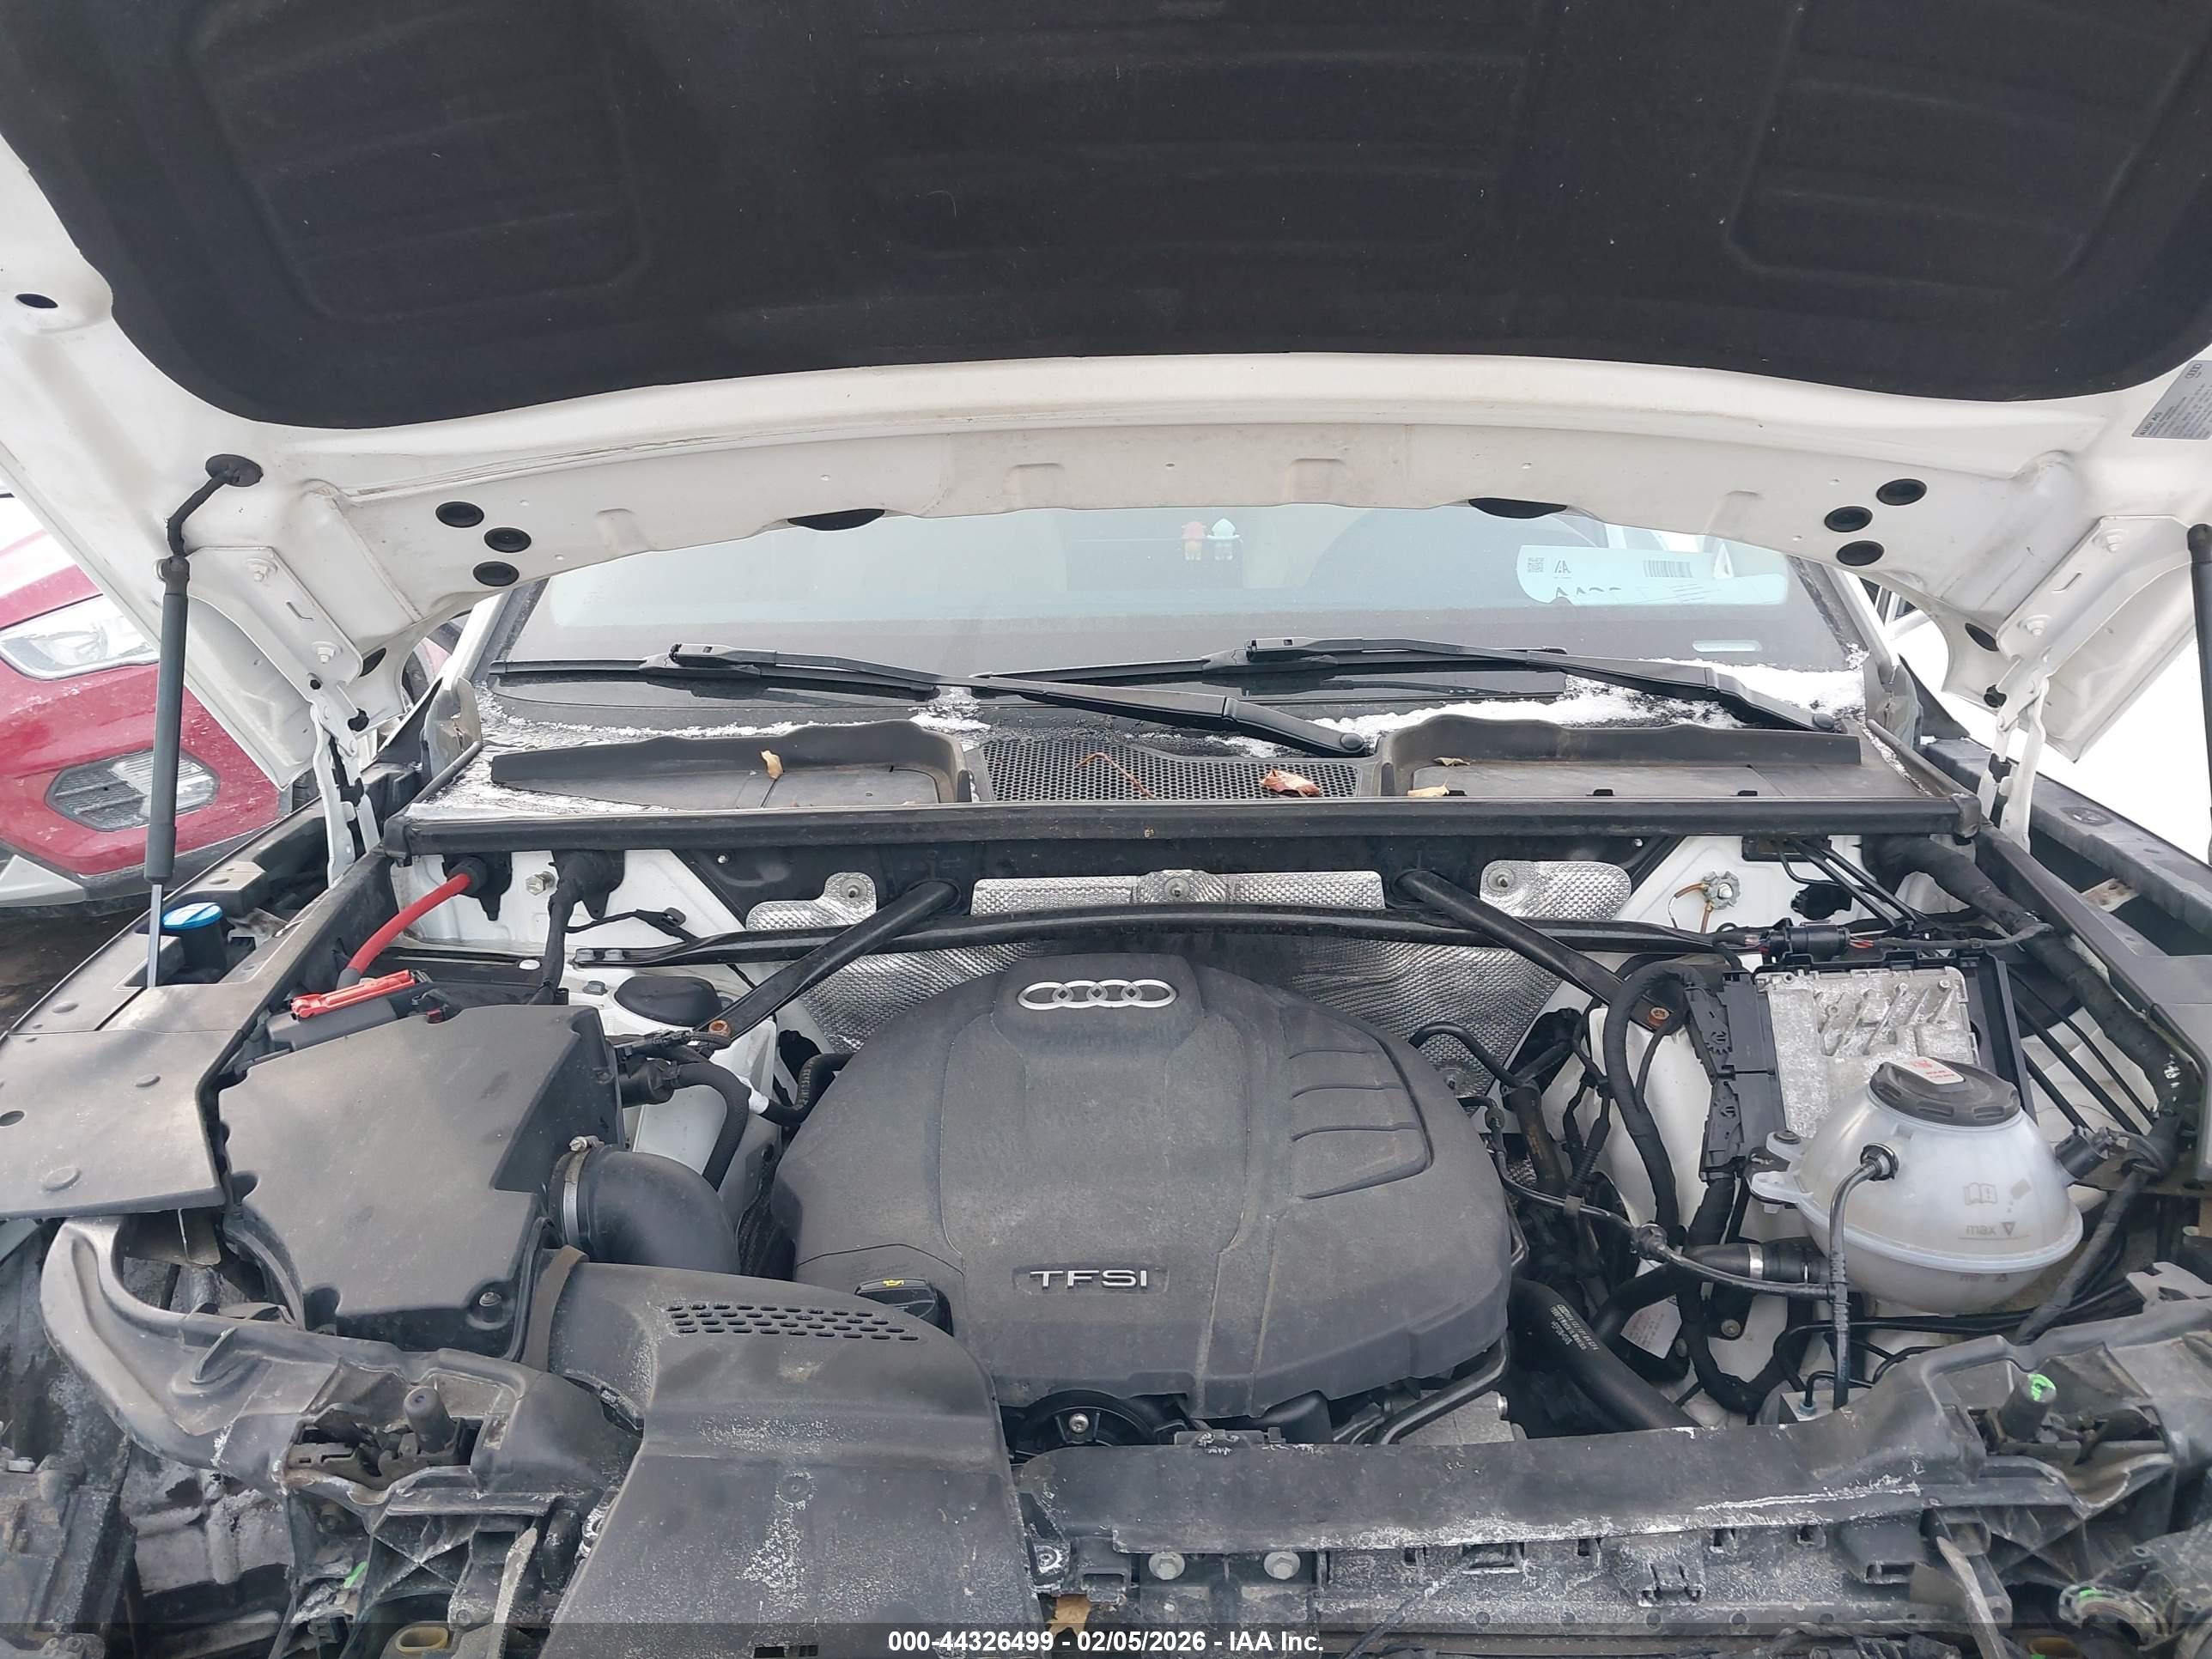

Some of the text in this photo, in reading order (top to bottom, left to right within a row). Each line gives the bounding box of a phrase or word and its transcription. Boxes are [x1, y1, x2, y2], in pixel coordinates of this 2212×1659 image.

[2140, 422, 2153, 435] AUDI
[1966, 1224, 1997, 1236] max
[1030, 1269, 1148, 1290] TFSI
